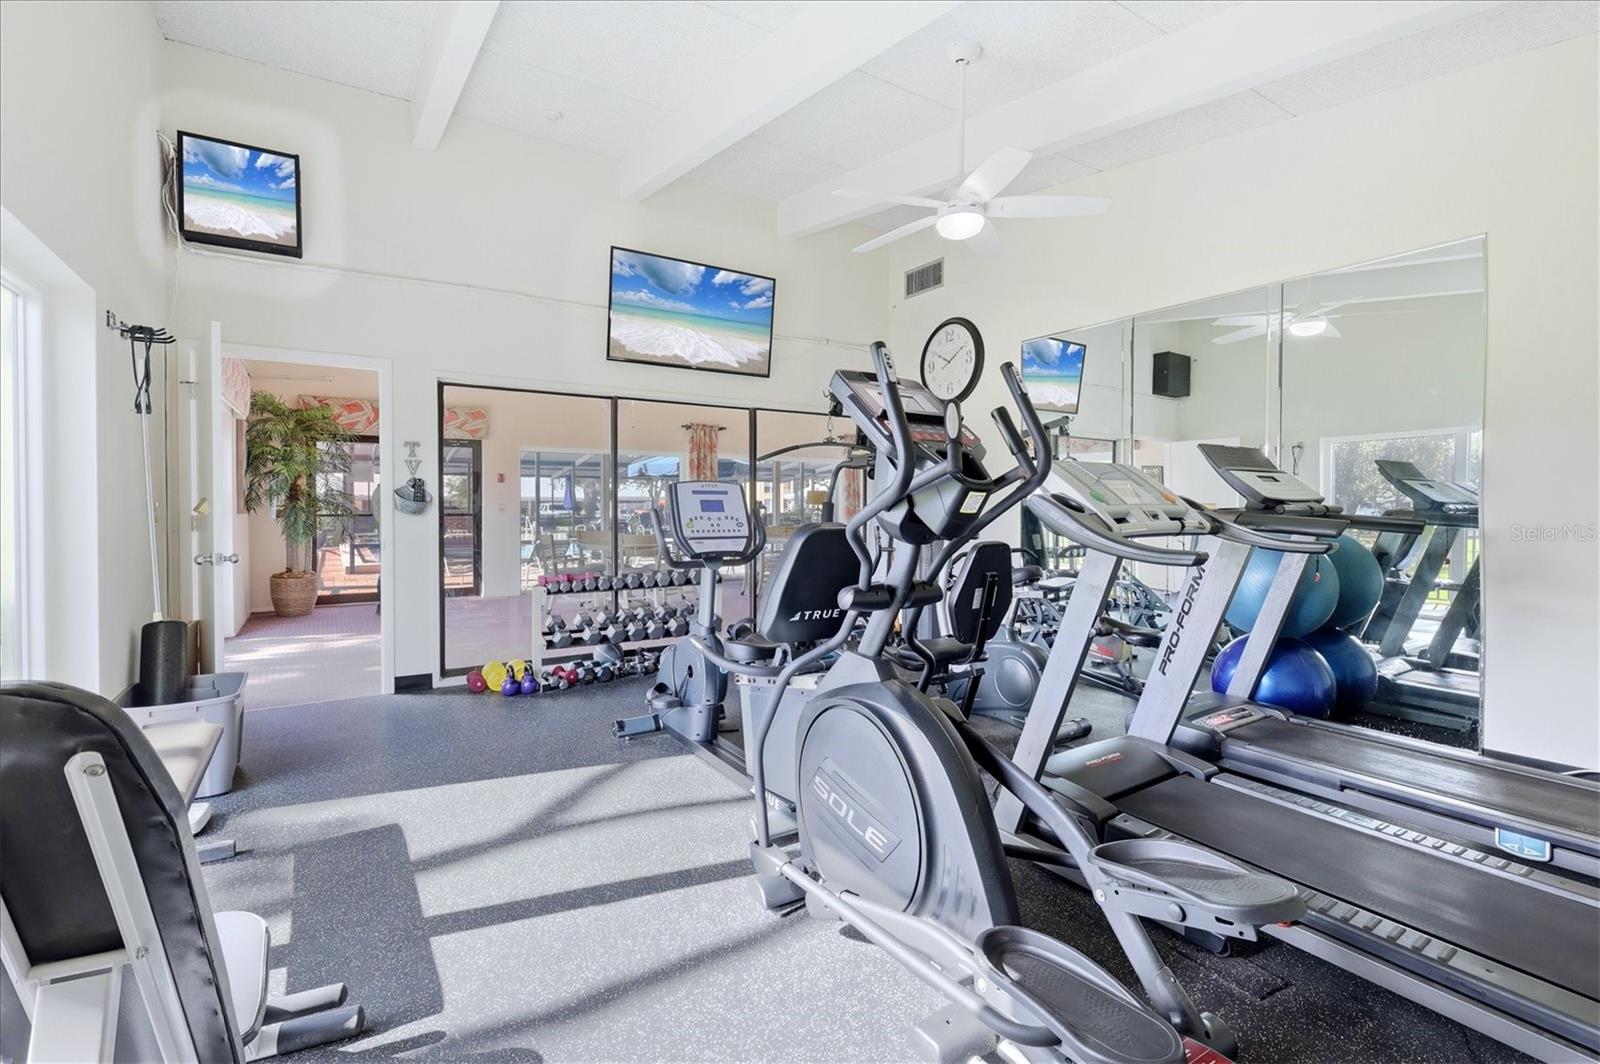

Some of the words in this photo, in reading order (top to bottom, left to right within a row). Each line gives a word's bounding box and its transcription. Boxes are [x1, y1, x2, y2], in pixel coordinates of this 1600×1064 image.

[945, 330, 955, 343] 12
[965, 350, 973, 364] 3
[928, 361, 935, 374] 9
[946, 382, 954, 395] 6
[804, 608, 841, 620] TRUE
[1159, 565, 1206, 676] PRO-FORM
[813, 776, 888, 854] SOLE
